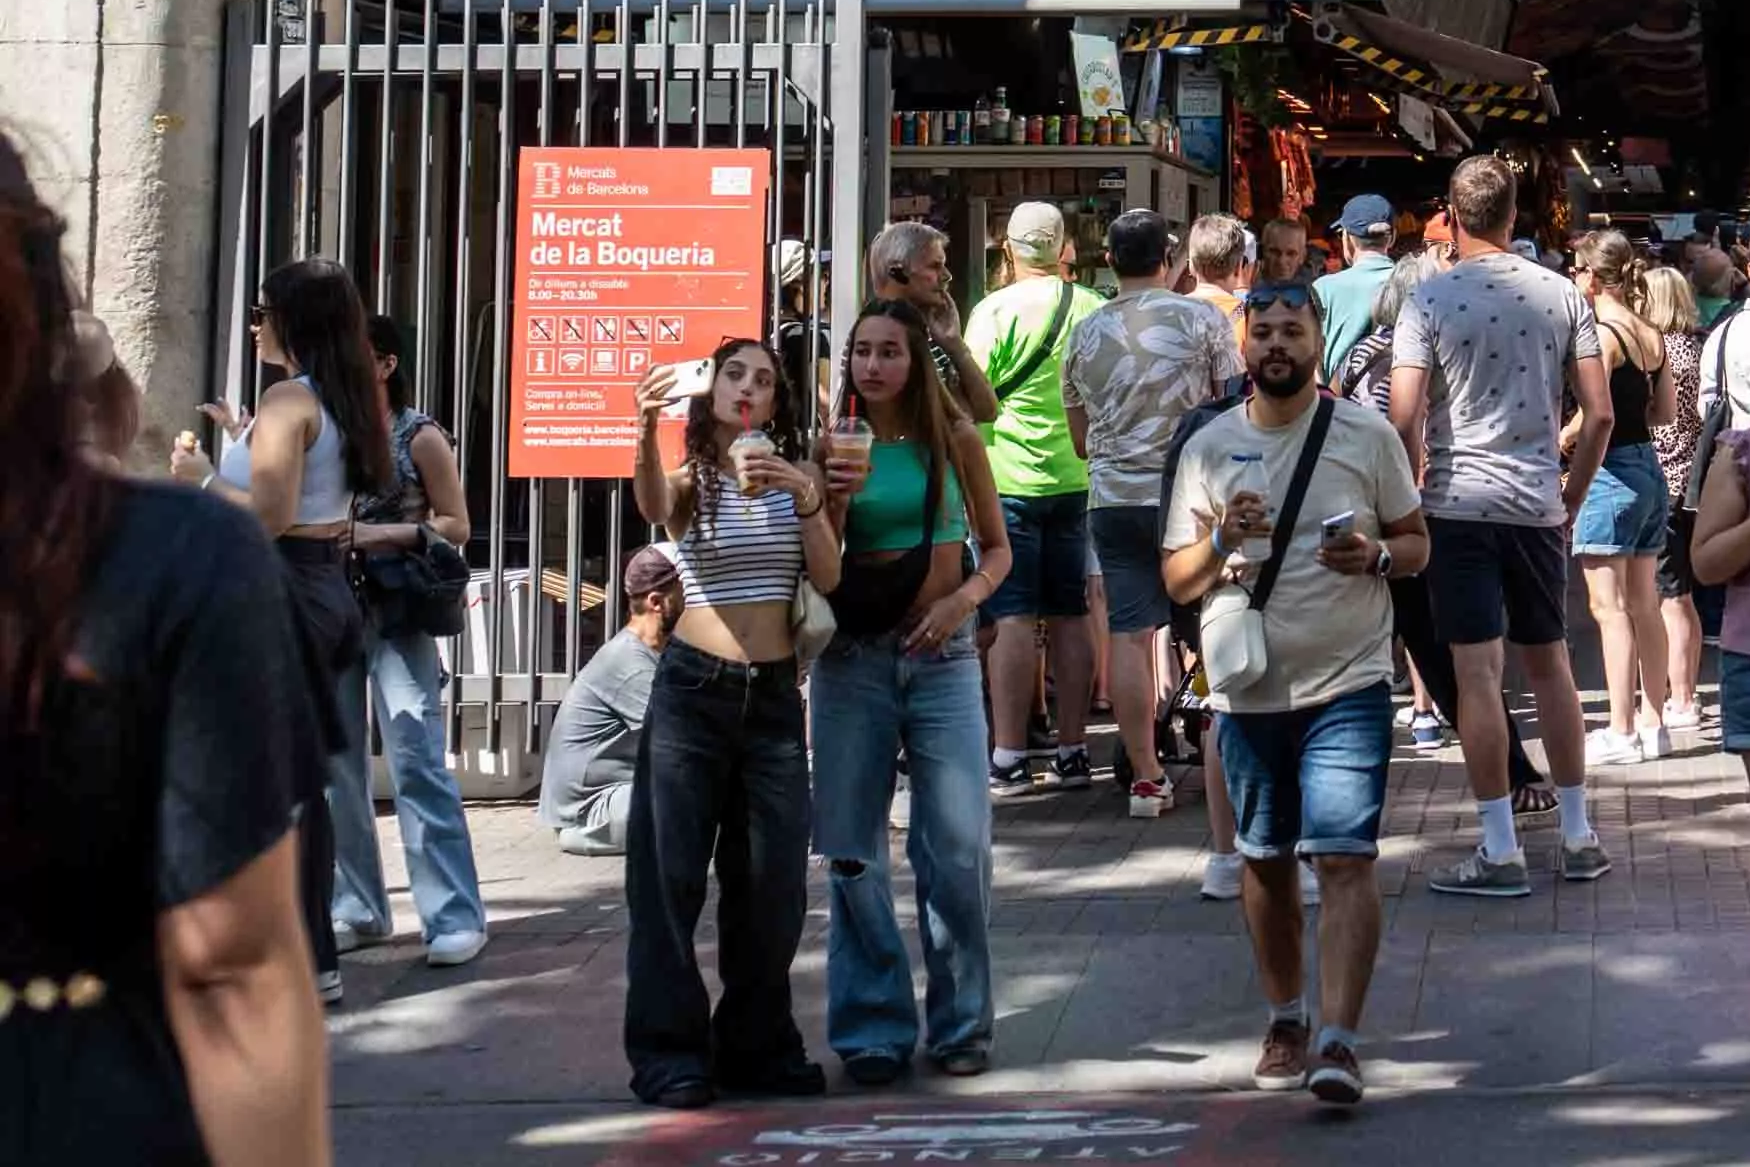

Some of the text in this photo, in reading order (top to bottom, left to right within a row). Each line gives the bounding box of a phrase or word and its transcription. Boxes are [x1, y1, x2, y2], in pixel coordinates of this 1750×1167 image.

[567, 166, 617, 179] Mercats
[567, 182, 649, 196] de Barcelona
[532, 212, 623, 236] Mercat
[530, 241, 715, 270] de la Boqueria
